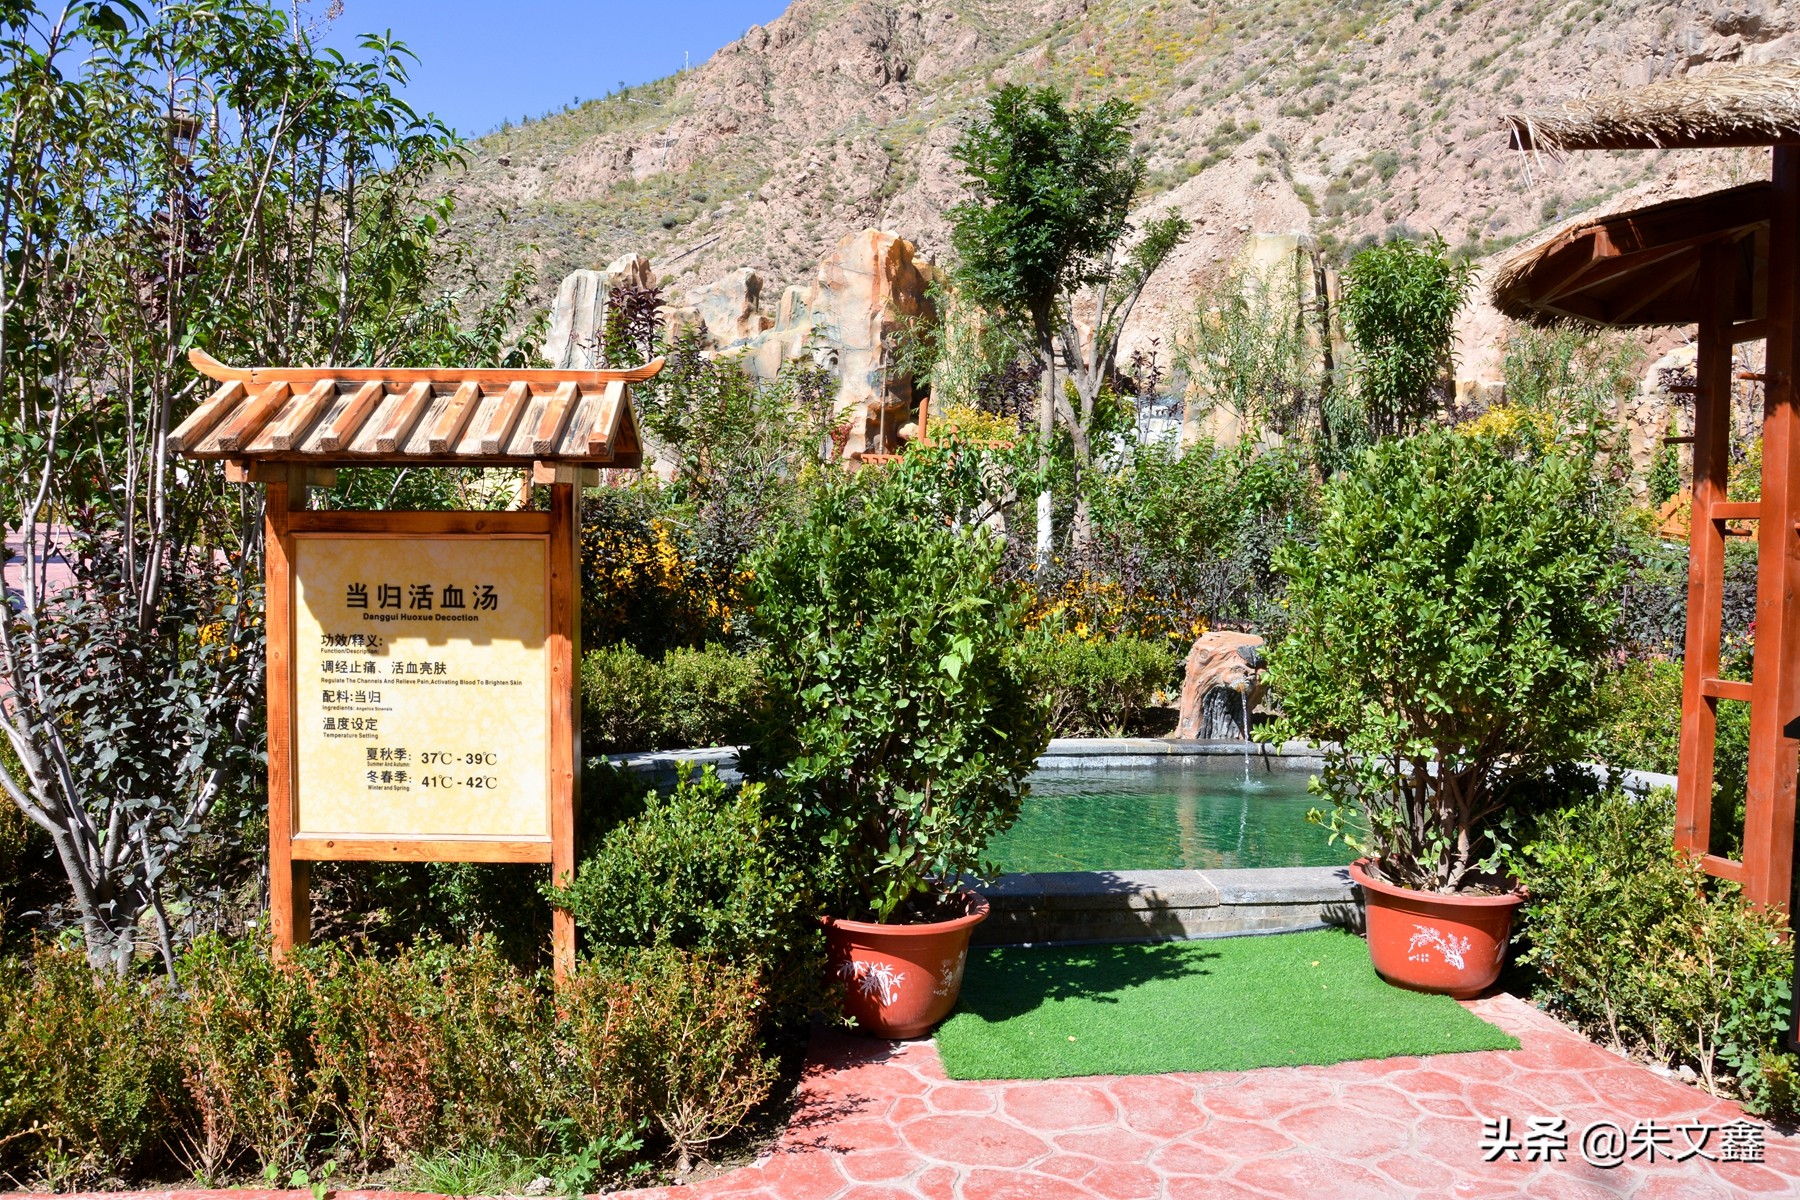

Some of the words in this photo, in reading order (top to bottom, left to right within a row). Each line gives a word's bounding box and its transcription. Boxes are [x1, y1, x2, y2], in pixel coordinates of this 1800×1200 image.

[346, 583, 498, 610] 当归活血汤
[363, 613, 399, 622] Danggui
[435, 614, 479, 622] Decoction
[321, 660, 448, 675] 调经止痛、活血亮肤
[323, 717, 378, 731] 温度设定
